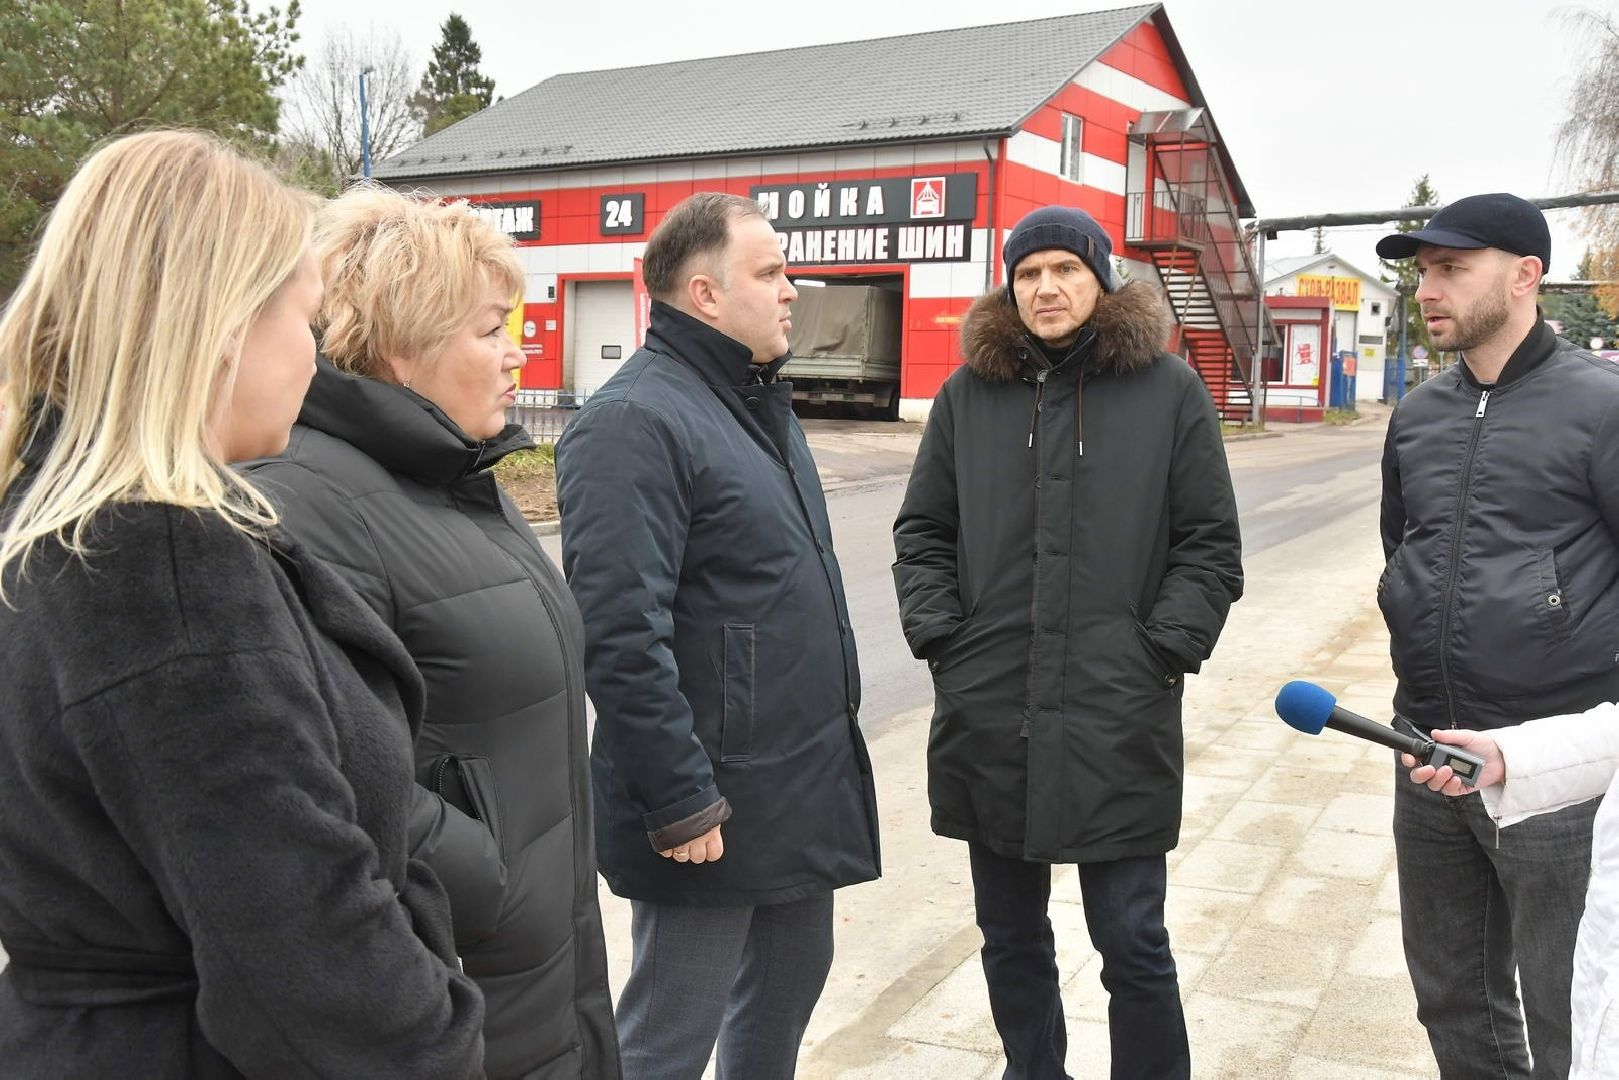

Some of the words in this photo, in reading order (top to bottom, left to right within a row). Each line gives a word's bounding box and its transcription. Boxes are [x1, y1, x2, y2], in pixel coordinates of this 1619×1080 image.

[605, 200, 633, 228] 24
[758, 182, 885, 220] МОЙКА
[469, 206, 534, 233] ТАЖ
[776, 228, 889, 263] РАНЕНИЕ
[897, 225, 964, 260] ШИН
